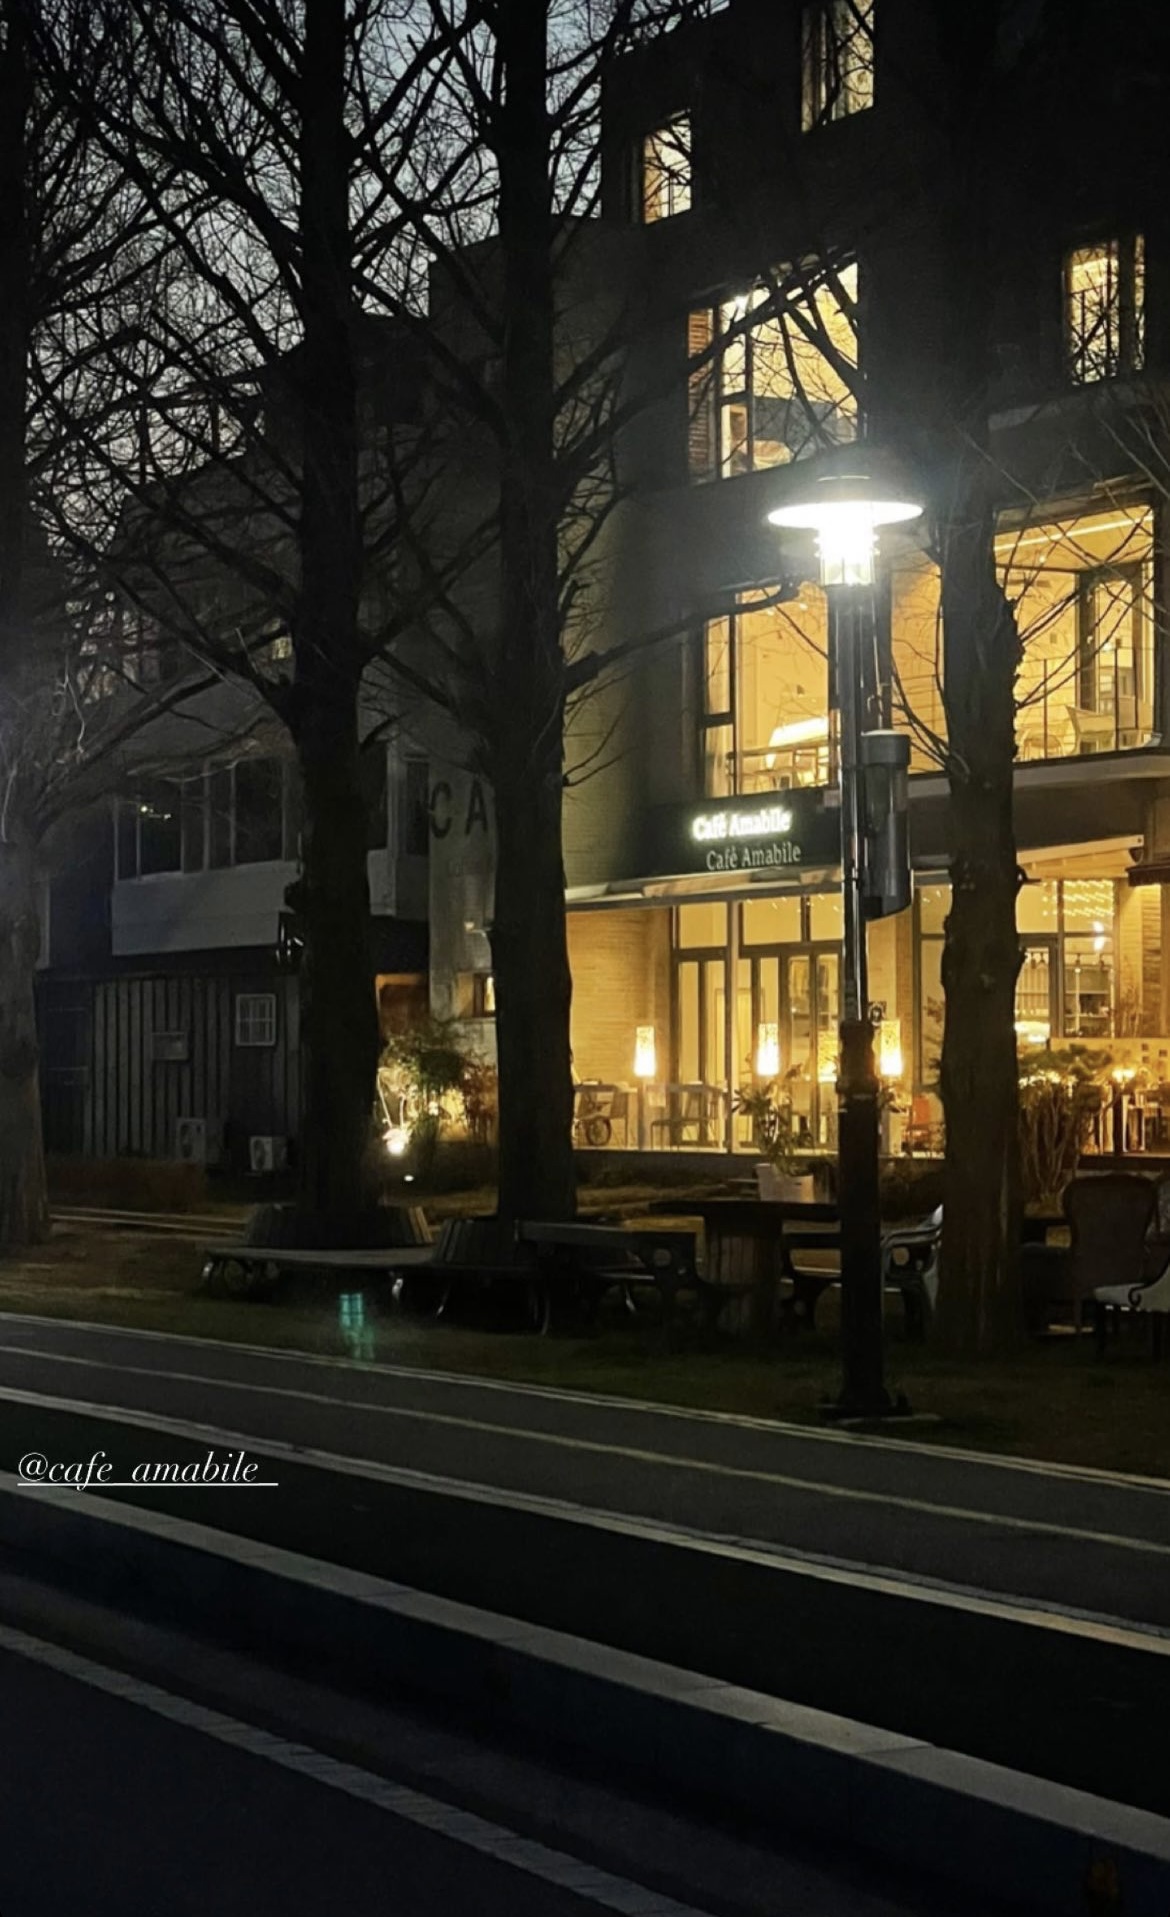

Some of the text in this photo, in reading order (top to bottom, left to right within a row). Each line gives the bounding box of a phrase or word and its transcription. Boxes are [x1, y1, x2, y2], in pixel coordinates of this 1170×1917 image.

[729, 805, 792, 837] Amabile
[706, 842, 801, 870] Café Amabile
